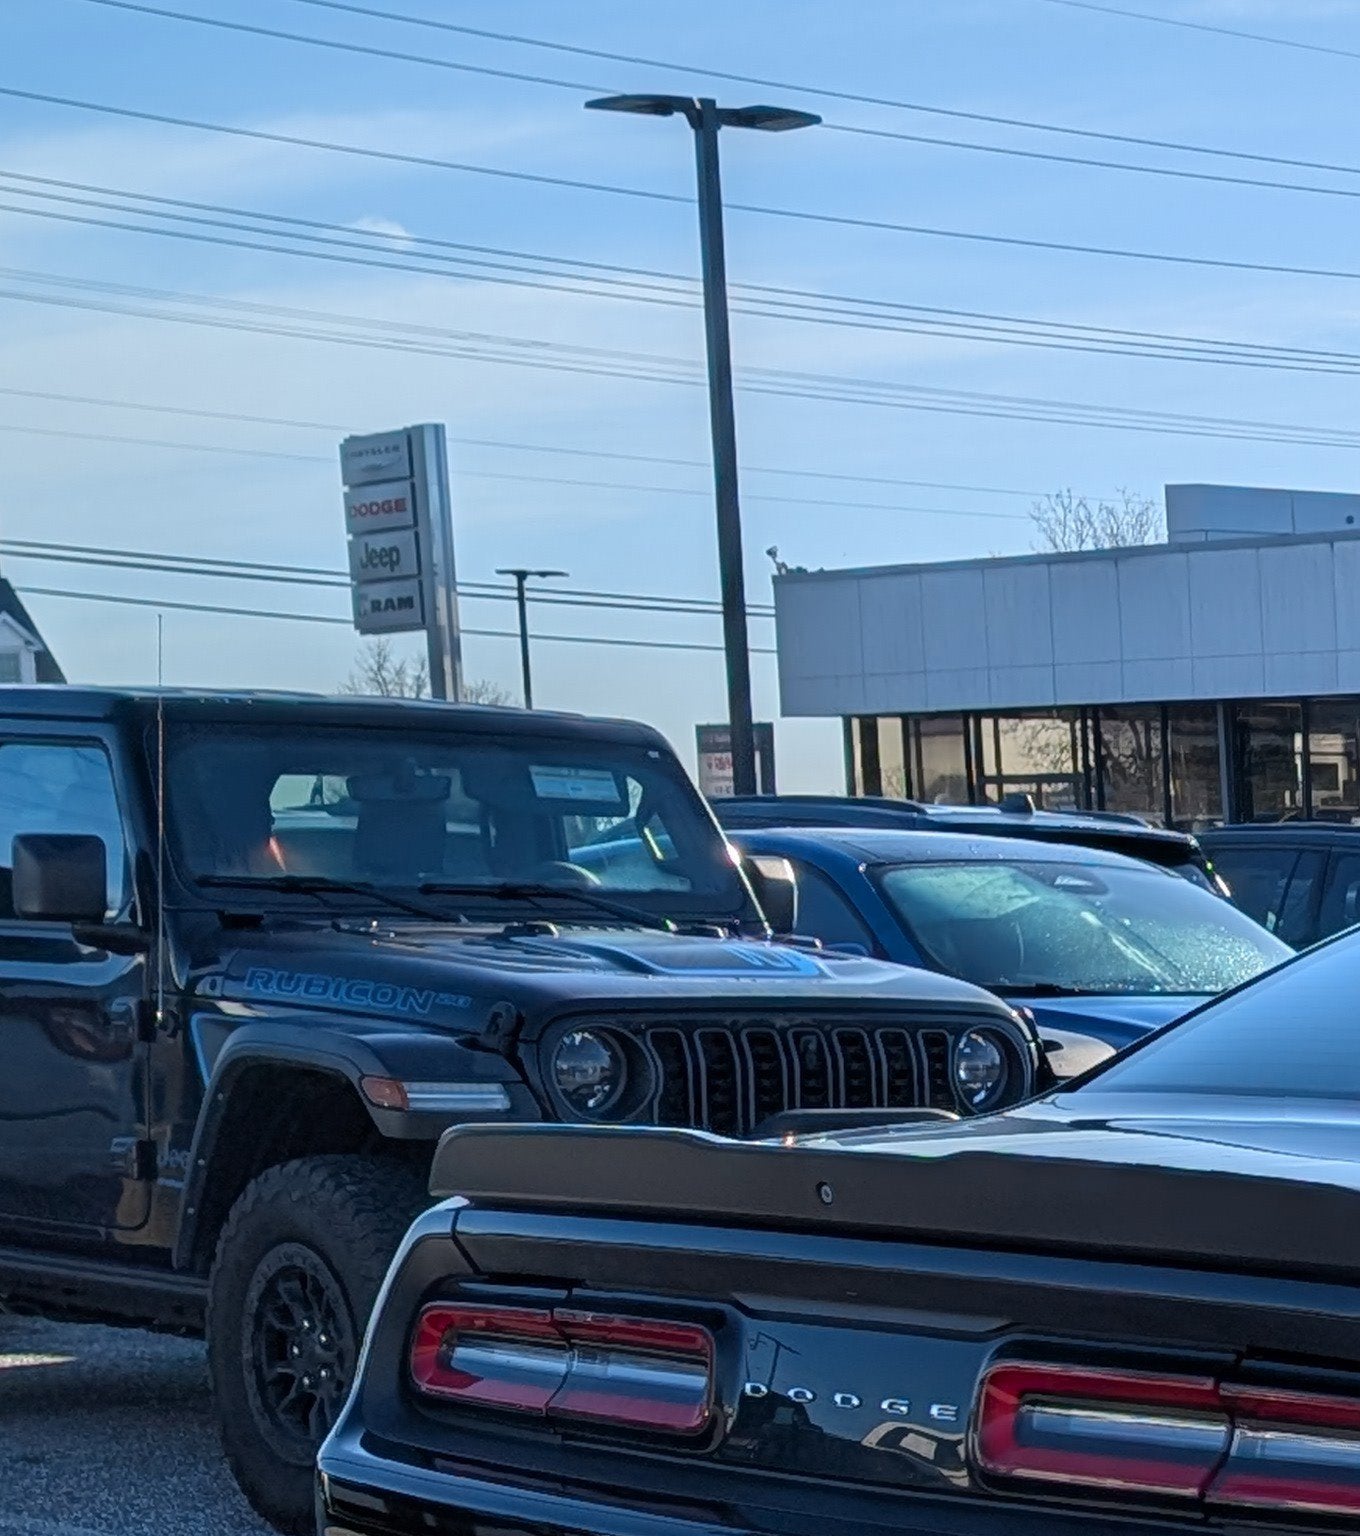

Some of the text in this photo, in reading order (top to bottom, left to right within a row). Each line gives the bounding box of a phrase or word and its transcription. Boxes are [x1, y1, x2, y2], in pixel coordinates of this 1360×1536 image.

[360, 542, 401, 573] Jeep
[370, 595, 415, 613] RAM
[245, 968, 436, 1014] RUBICON
[744, 1381, 959, 1422] DODGE
